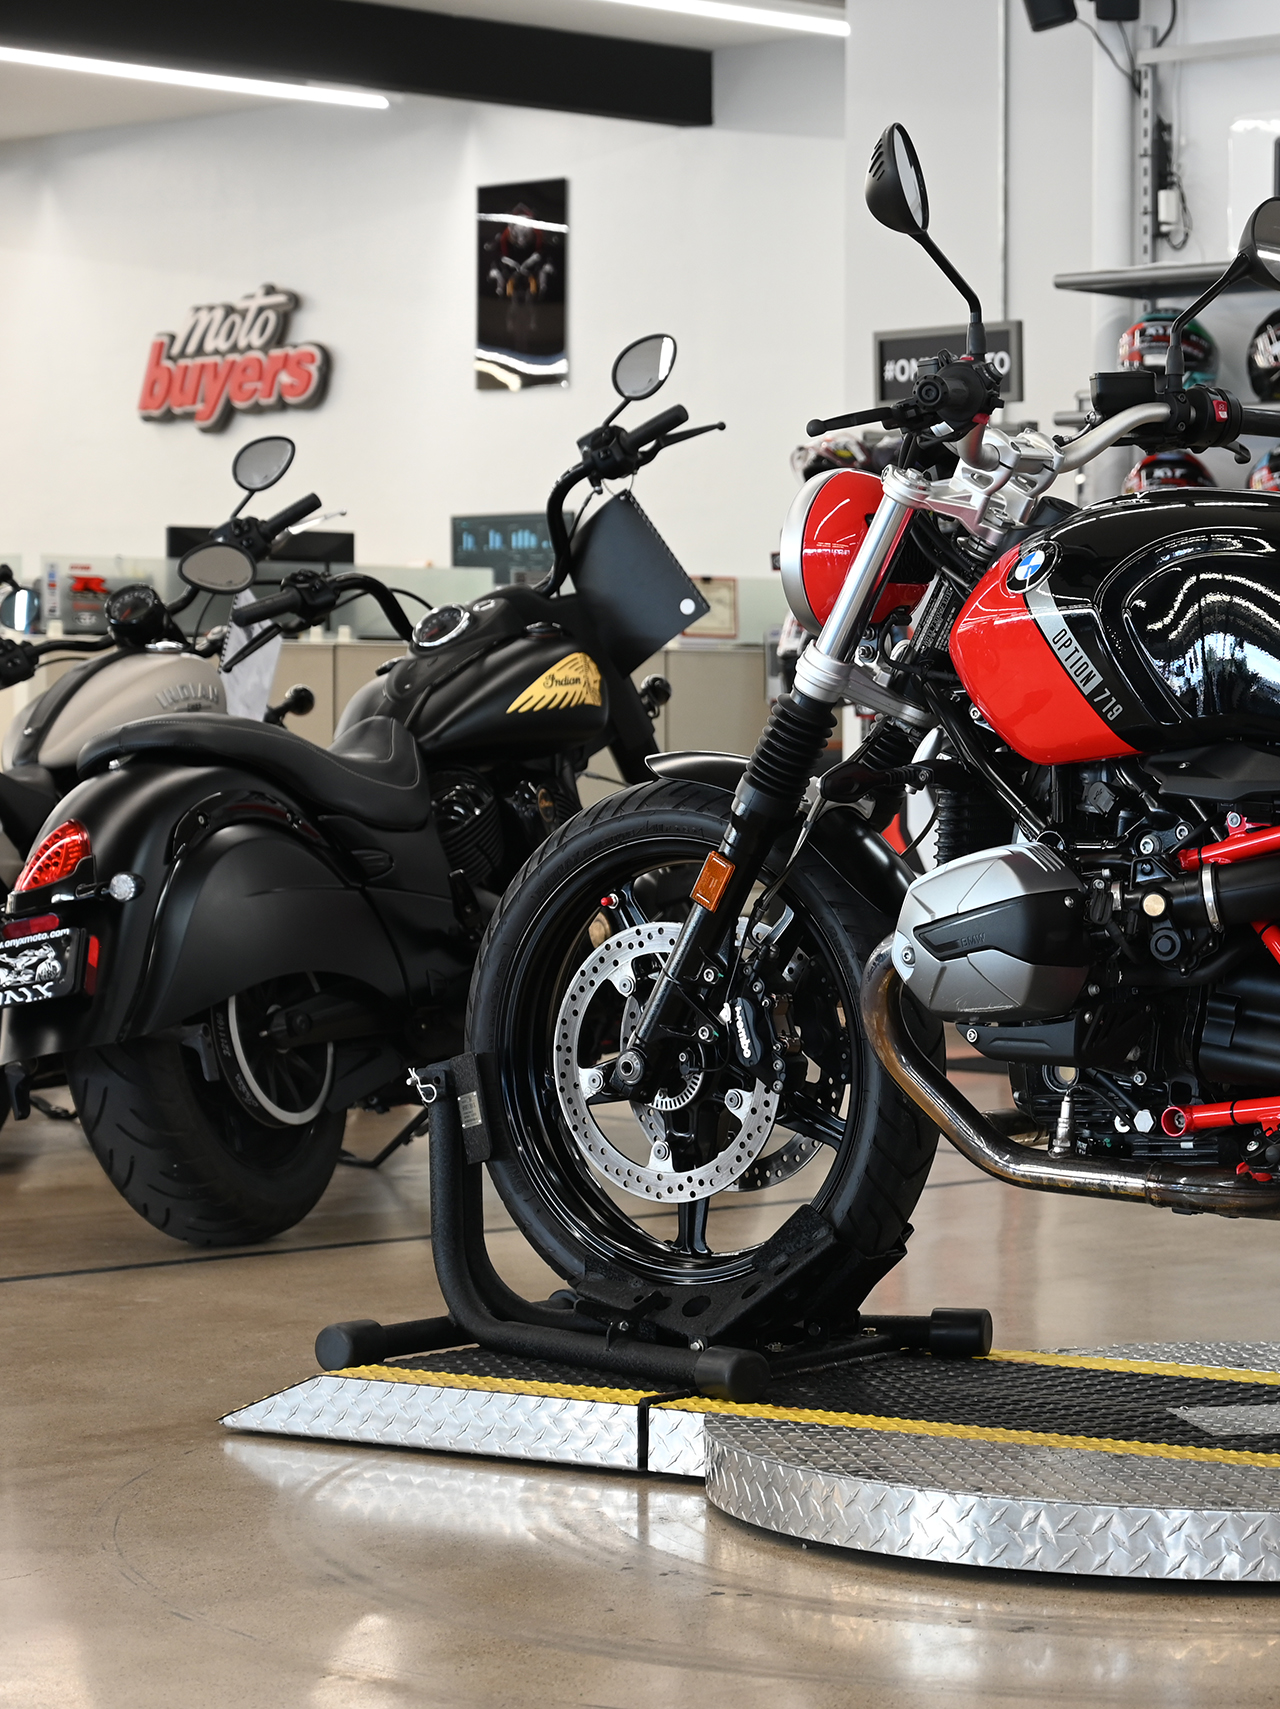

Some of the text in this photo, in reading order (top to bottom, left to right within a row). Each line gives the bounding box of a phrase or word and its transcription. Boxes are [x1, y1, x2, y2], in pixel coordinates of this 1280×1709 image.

[138, 337, 320, 424] buyers
[543, 673, 581, 689] Indian
[1052, 628, 1123, 721] OPTION 719
[155, 682, 219, 710] INDIAN
[960, 932, 986, 947] BMW
[735, 1005, 752, 1058] brembo
